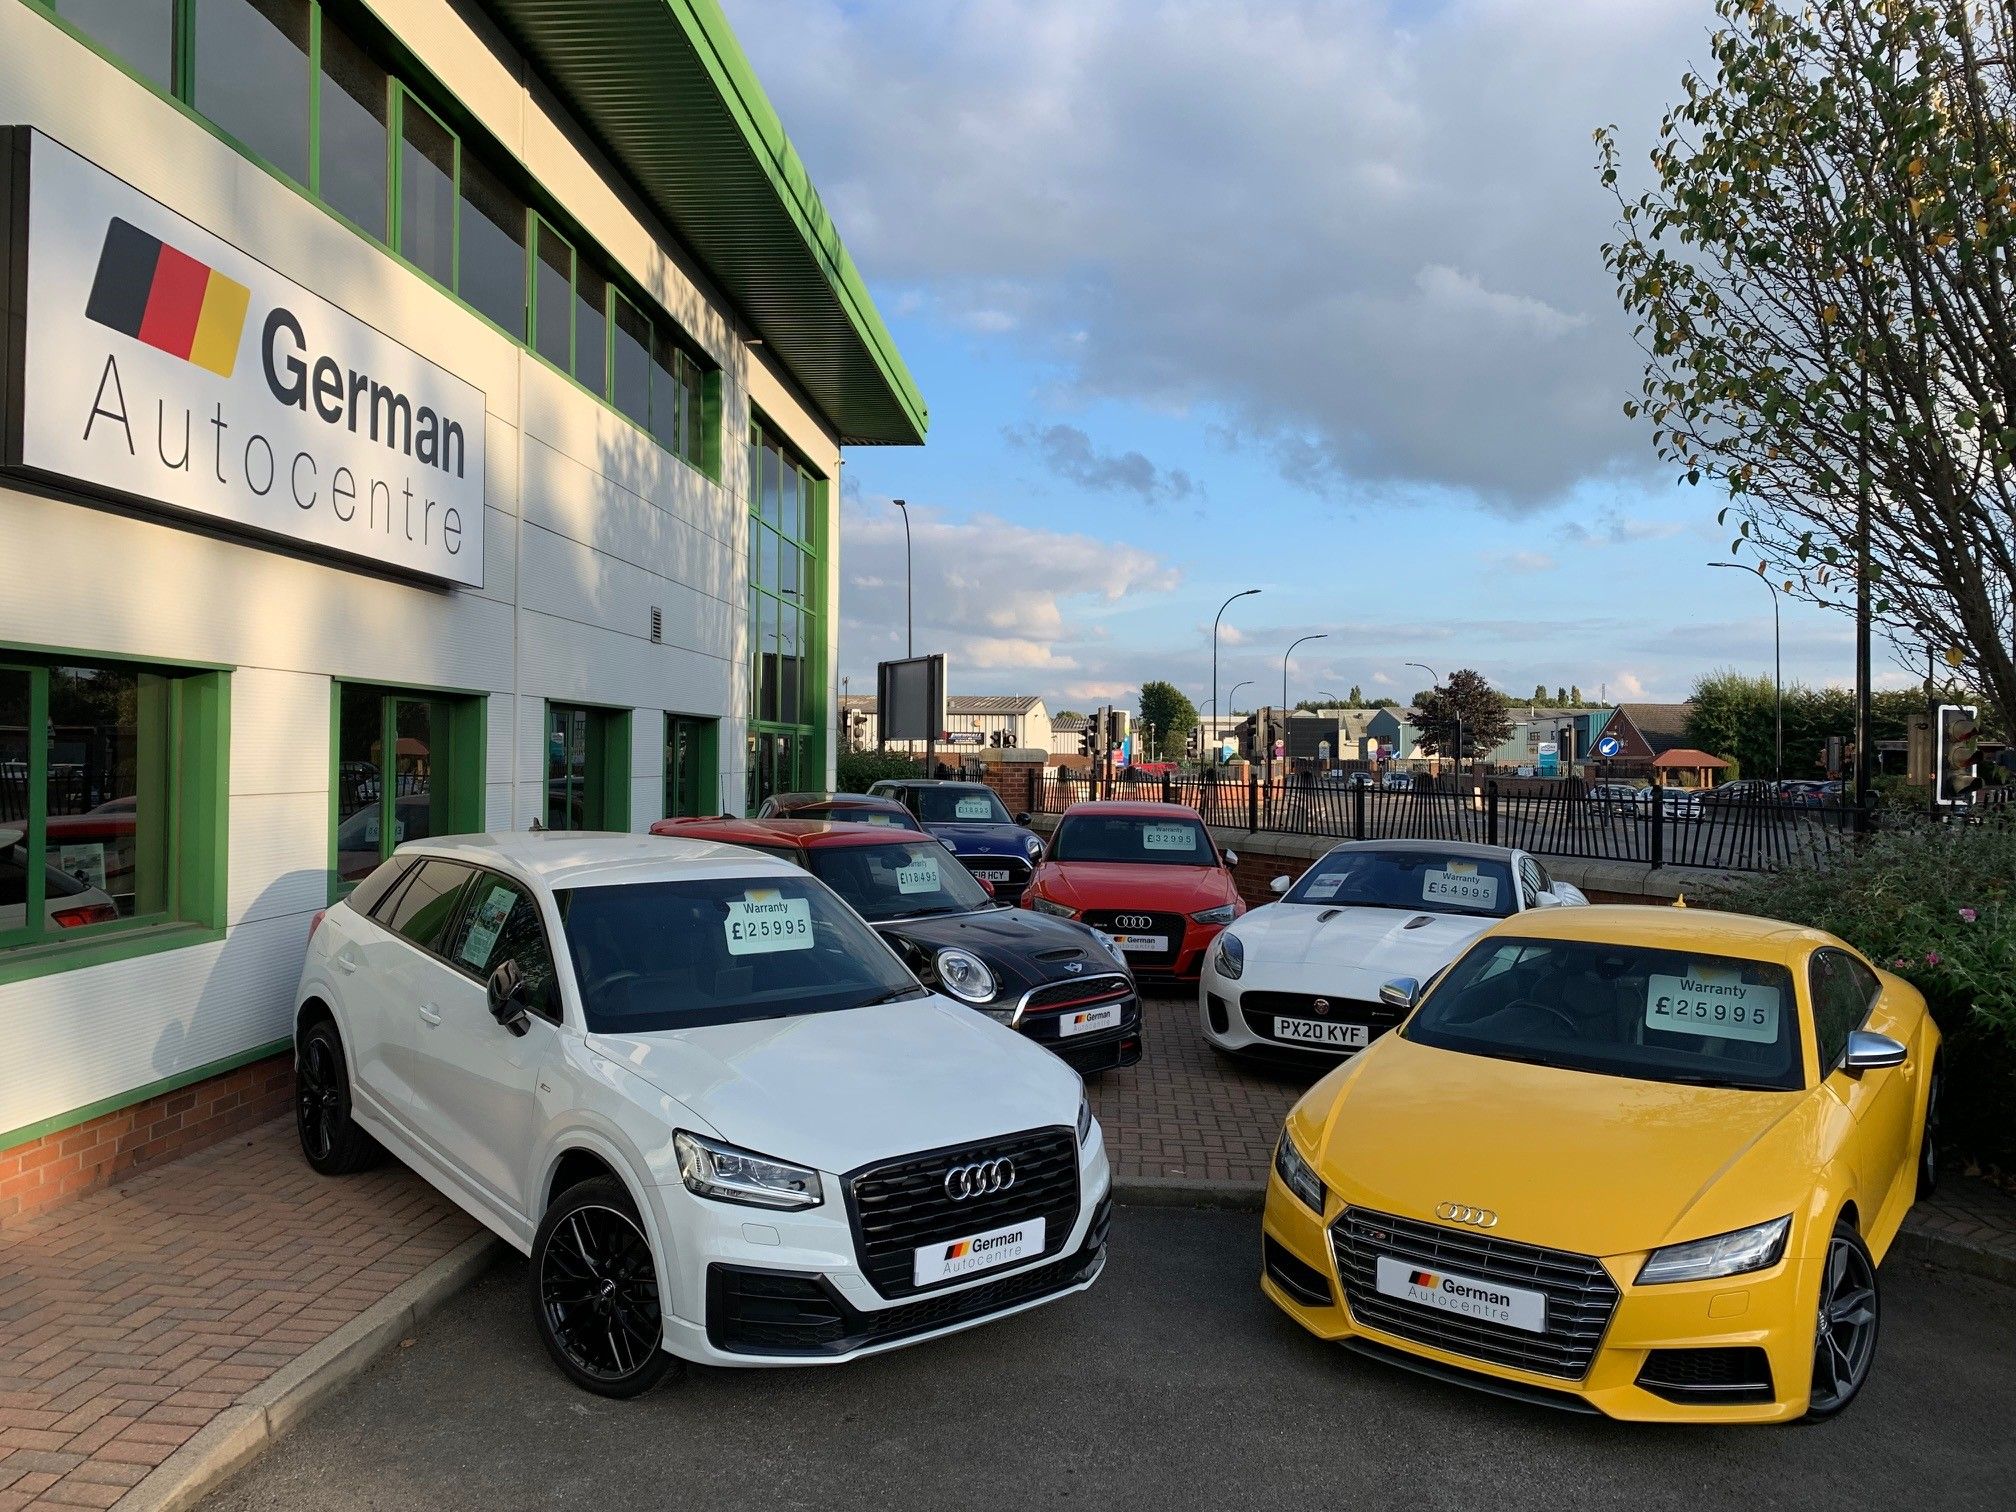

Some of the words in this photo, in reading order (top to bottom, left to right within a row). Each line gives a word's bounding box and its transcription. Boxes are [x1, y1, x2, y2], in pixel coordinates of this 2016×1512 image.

[262, 307, 465, 479] German
[83, 354, 464, 555] Autocentre
[1147, 834, 1192, 843] £32995
[900, 872, 937, 884] £18495
[988, 871, 1004, 880] HCY
[1442, 872, 1480, 885] Warranty
[1428, 882, 1490, 898] £54995
[743, 902, 788, 913] Warranty
[732, 919, 806, 940] £25995
[1680, 979, 1747, 999] Warranty
[1086, 1011, 1111, 1021] German
[1655, 996, 1765, 1024] £25995
[1281, 1020, 1323, 1039] PX20
[1328, 1025, 1361, 1042] KYF
[972, 1231, 1022, 1253] German
[943, 1246, 1022, 1275] Autocentre
[1408, 1286, 1509, 1321] Autocentre
[1442, 1279, 1510, 1307] German
